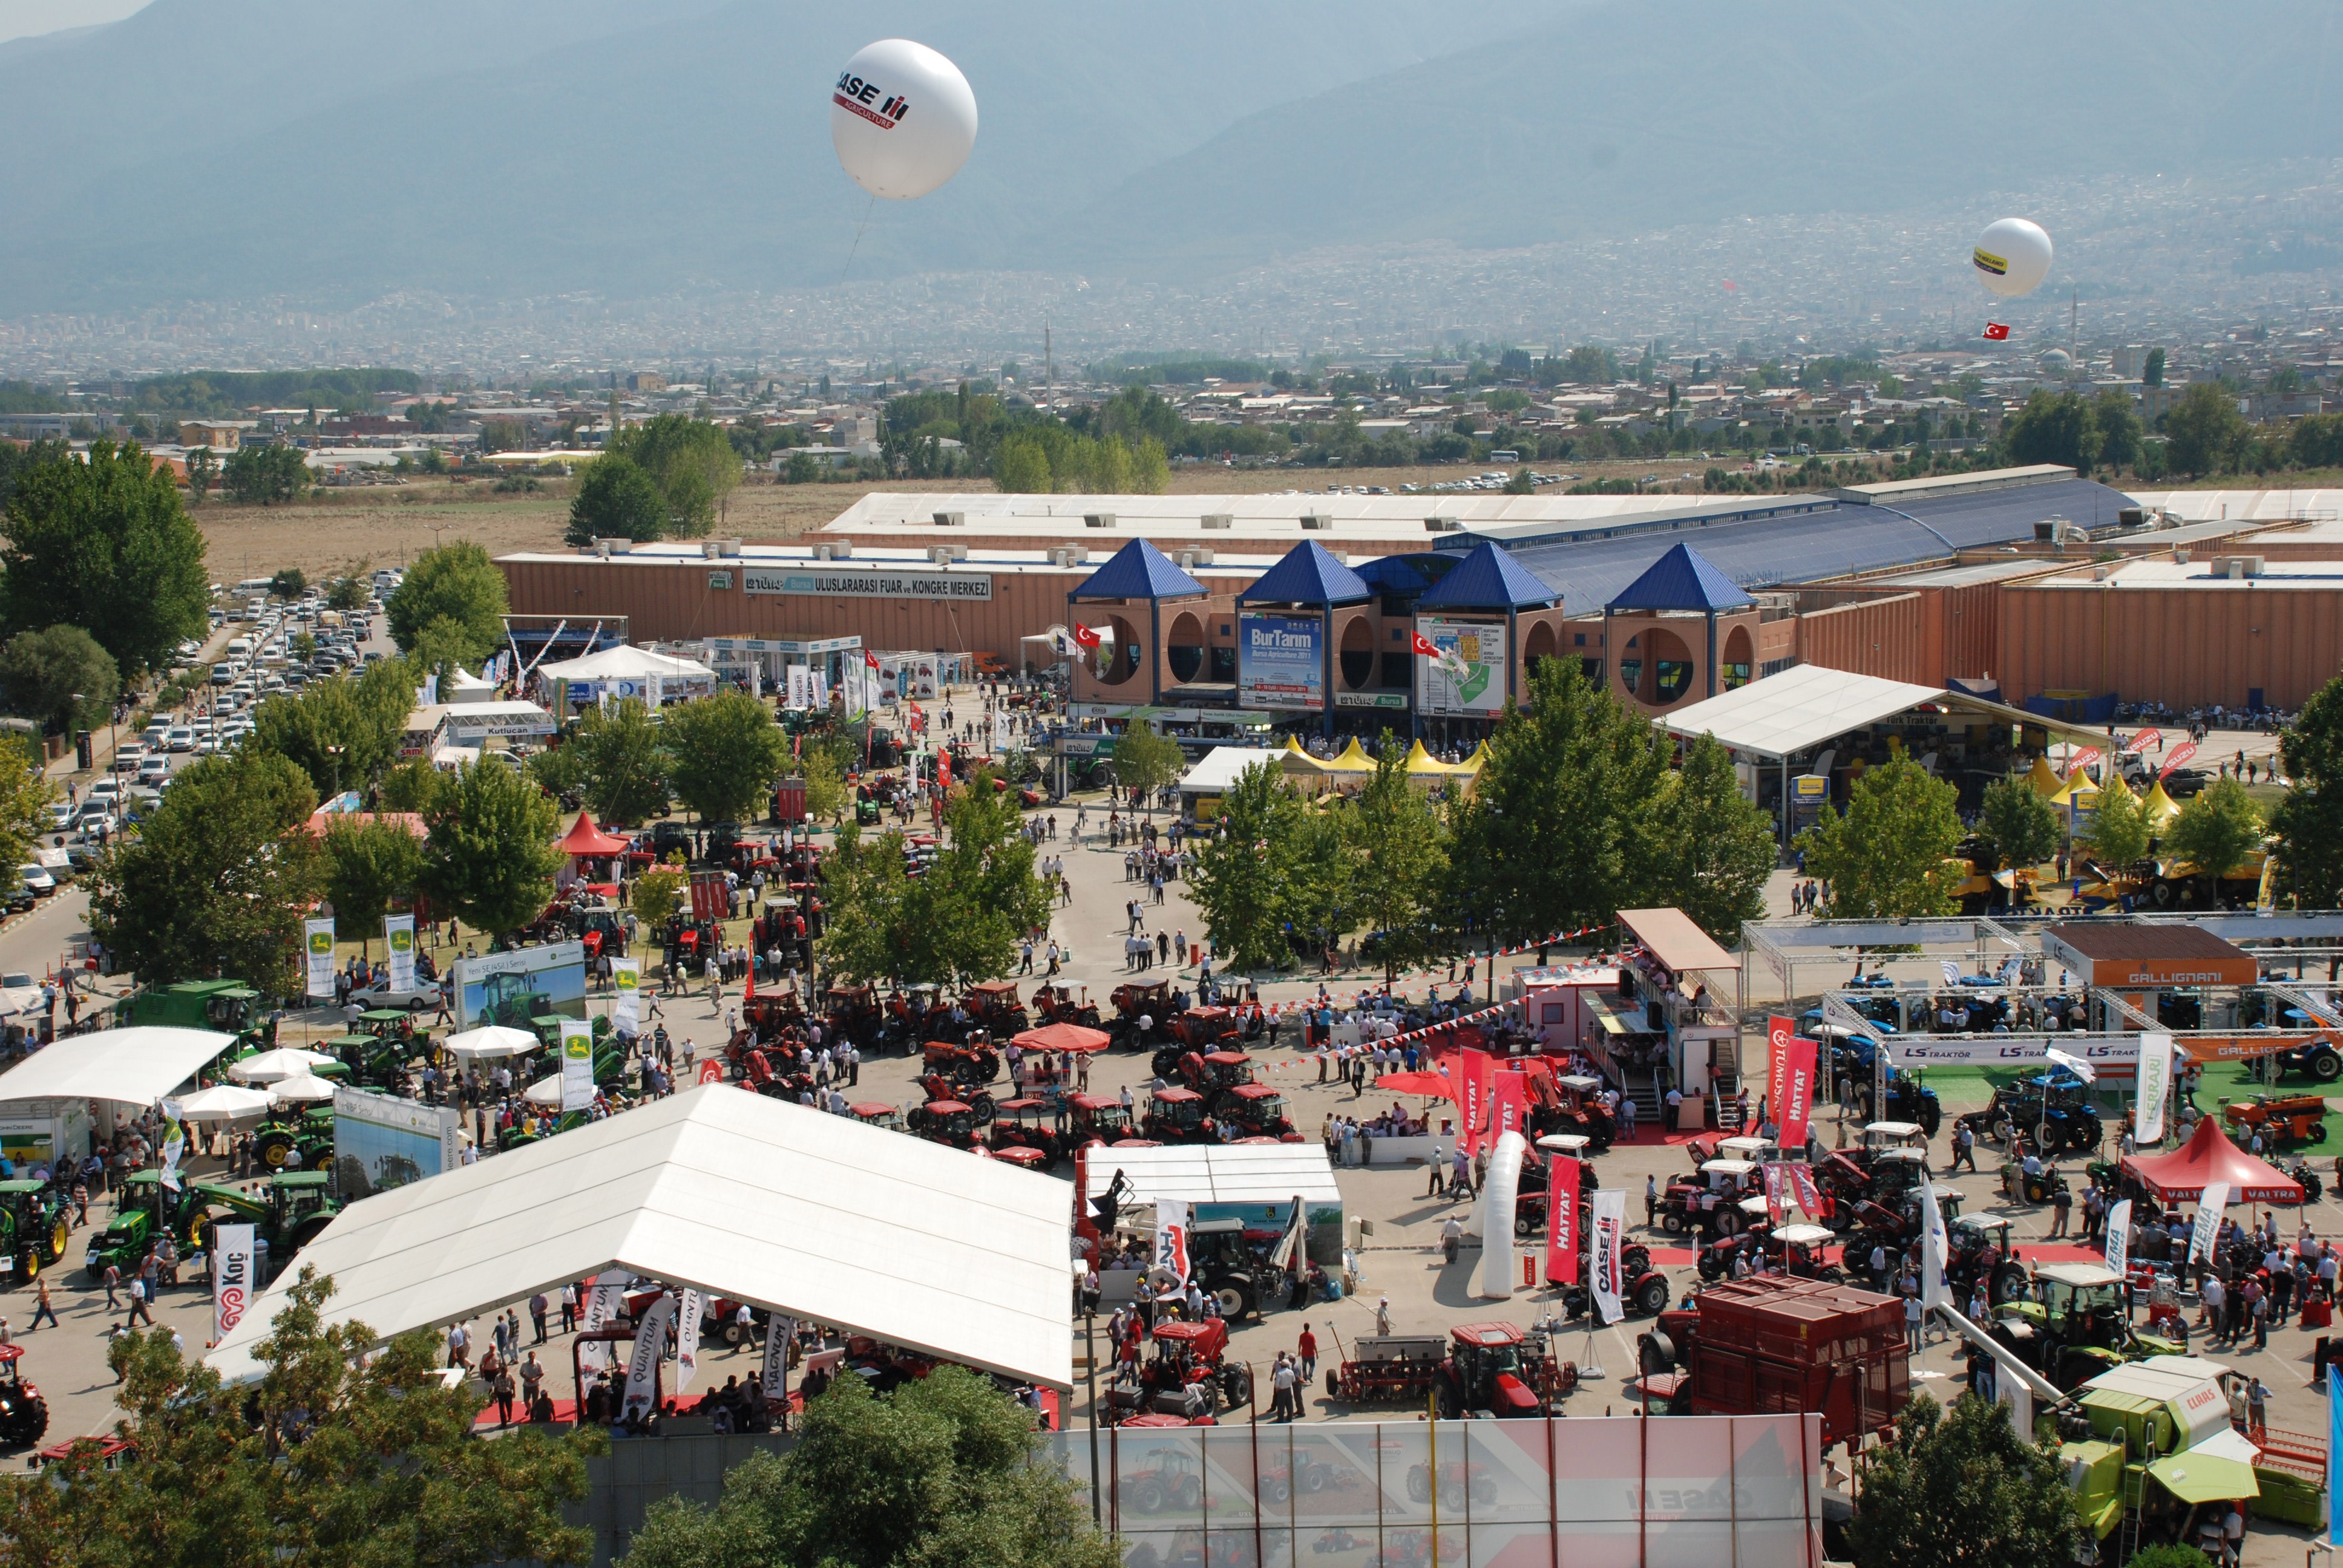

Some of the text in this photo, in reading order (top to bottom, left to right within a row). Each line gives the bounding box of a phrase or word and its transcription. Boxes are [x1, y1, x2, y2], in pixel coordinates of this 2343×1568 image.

[845, 101, 892, 129] AGRICULTURE
[1981, 256, 2004, 267] HOLLAND
[756, 576, 784, 590] TÜYAP
[791, 580, 811, 589] Bursa
[815, 578, 877, 592] ULUSLARARASI
[880, 580, 902, 593] FUAR
[913, 580, 948, 595] KONGRE
[951, 580, 989, 596] MERKEZİ
[1251, 629, 1311, 648] BurTarım
[1349, 694, 1375, 705] TÜYAP
[1887, 716, 1938, 725] Türk Traktör
[2129, 732, 2158, 751] ISUZU
[2069, 750, 2099, 770] ISUZU
[2165, 746, 2195, 768] ISUZU
[2054, 942, 2063, 961] LS
[510, 959, 526, 968] Serisi
[2129, 972, 2222, 983] GALLIGNANI
[1828, 1006, 1836, 1018] LS
[1905, 1048, 1927, 1057] LS
[2000, 1047, 2022, 1057] LS
[2086, 1047, 2109, 1057] LS
[1789, 1068, 1806, 1122] HATTAT
[2146, 1058, 2161, 1120] FERRARI
[1468, 1078, 1477, 1130] HATTAT
[2247, 1189, 2297, 1200] VALTRA
[1557, 1188, 1570, 1250] HATTAT
[222, 1252, 249, 1285] Koç
[1598, 1235, 1611, 1293] CASE
[586, 1283, 611, 1353] QANTUM
[634, 1316, 659, 1383] QUANTUM
[767, 1323, 786, 1391] MAGNUM
[2186, 1388, 2216, 1410] CLAAS
